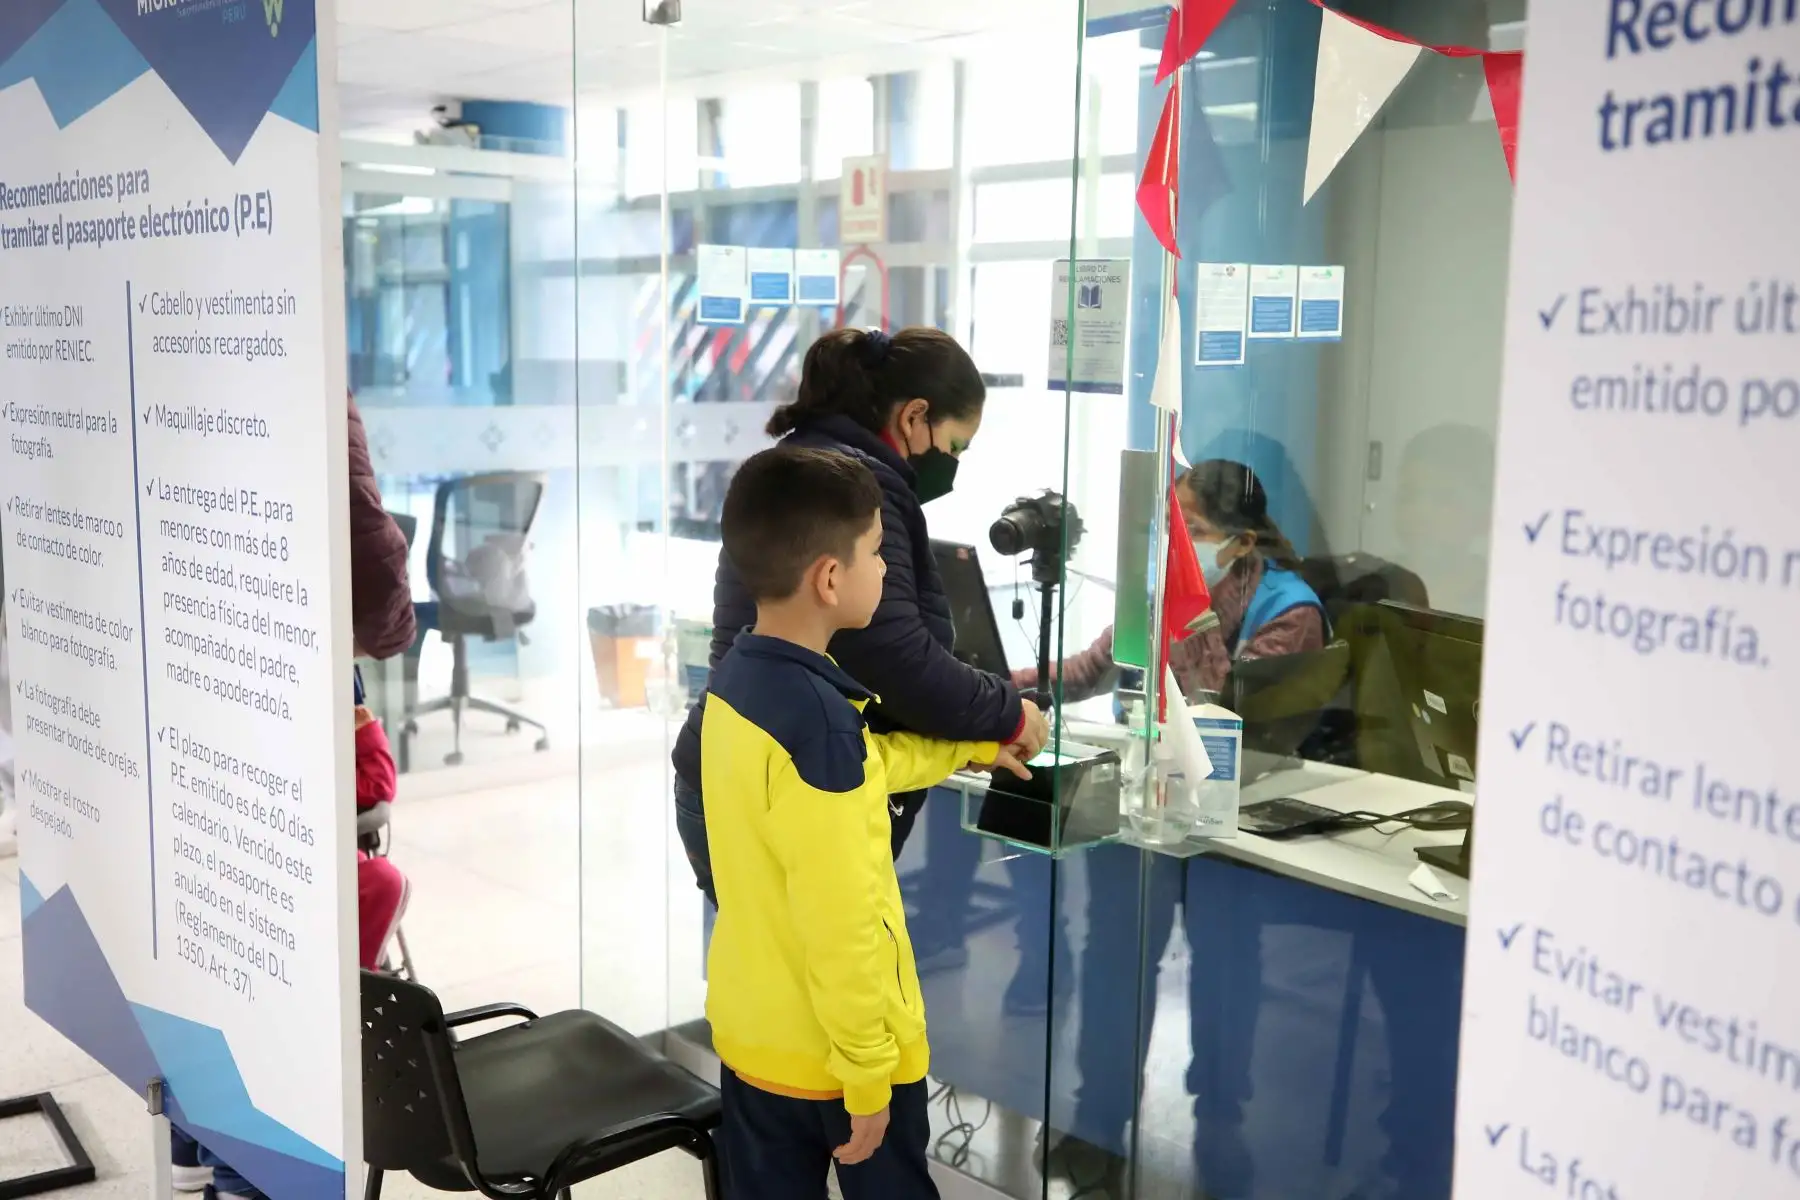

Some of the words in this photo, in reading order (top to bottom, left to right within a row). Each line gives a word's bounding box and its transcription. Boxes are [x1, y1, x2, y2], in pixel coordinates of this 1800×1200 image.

[0, 170, 113, 211] Recomendaciones
[117, 168, 149, 203] para
[1, 217, 49, 250] tramitar
[52, 214, 64, 245] el
[66, 211, 136, 250] pasaporte
[140, 200, 230, 238] electrónico
[234, 189, 273, 238] (P.E)
[4, 305, 33, 327] Exhibir
[35, 305, 63, 327] último
[65, 305, 83, 327] DNI
[151, 291, 194, 316] Cabello
[196, 297, 203, 320] y
[206, 291, 274, 316] vestimenta
[277, 289, 296, 315] sin
[1576, 283, 1725, 336] Exhibir
[7, 338, 37, 359] emitido
[39, 344, 53, 364] por
[56, 340, 95, 362] RENIEC.
[152, 330, 211, 356] accesorios
[214, 330, 288, 362] recargados.
[1570, 362, 1728, 416] emitido
[10, 401, 51, 428] Expresión
[51, 408, 84, 430] neutral
[85, 414, 107, 435] para
[109, 410, 117, 434] la
[155, 403, 214, 438] Maquillaje
[216, 408, 270, 438] discreto.
[11, 433, 54, 460] fotografía.
[15, 496, 43, 520] Retirar
[45, 501, 71, 527] lentes
[72, 507, 84, 530] de
[85, 515, 115, 537] marco
[117, 522, 123, 538] o
[158, 477, 171, 501] La
[173, 486, 217, 513] entrega
[219, 487, 237, 510] del
[240, 489, 262, 517] P.E.
[264, 497, 294, 524] para
[16, 529, 27, 548] de
[28, 533, 64, 557] contacto
[65, 539, 77, 560] de
[78, 544, 104, 568] color.
[160, 517, 208, 545] menores
[210, 529, 232, 550] con
[234, 528, 259, 555] más
[261, 533, 277, 558] de
[280, 535, 289, 561] 8
[1560, 508, 1768, 584] Expresión
[162, 552, 187, 577] años
[189, 553, 203, 581] de
[205, 561, 238, 591] edad,
[239, 569, 294, 604] requiere
[296, 577, 309, 607] la
[19, 588, 44, 613] Evitar
[45, 596, 94, 631] vestimenta
[95, 609, 107, 634] de
[108, 615, 133, 643] color
[163, 589, 216, 621] presencia
[218, 597, 249, 631] física
[251, 607, 271, 638] del
[273, 620, 319, 654] menor,
[1555, 580, 1770, 668] fotografía.
[21, 619, 48, 646] blanco
[50, 632, 69, 654] para
[70, 635, 117, 671] fotografía.
[164, 624, 236, 664] acompañado
[238, 643, 257, 671] del
[259, 653, 300, 687] padre,
[25, 679, 35, 700] La
[35, 684, 77, 718] fotografía
[78, 700, 101, 729] debe
[166, 659, 201, 689] madre
[203, 672, 211, 686] o
[212, 675, 293, 722] apoderado/a.
[26, 714, 65, 744] presentar
[66, 728, 93, 759] borde
[94, 742, 107, 764] de
[108, 752, 140, 779] orejas.
[169, 726, 180, 750] El
[181, 733, 211, 765] plazo
[213, 747, 239, 772] para
[241, 761, 289, 800] recoger
[291, 776, 303, 803] el
[1546, 722, 1684, 801] Retirar
[29, 769, 62, 801] Mostrar
[64, 785, 72, 806] el
[73, 795, 101, 823] rostro
[30, 803, 74, 840] despejado.
[171, 761, 189, 790] P.E.
[191, 770, 234, 809] emitido
[235, 795, 249, 818] es
[251, 797, 267, 825] de
[269, 805, 286, 834] 60
[288, 814, 315, 847] días
[171, 800, 232, 846] calendario.
[234, 824, 283, 870] Vencido
[285, 855, 313, 885] este
[1539, 794, 1586, 846] de
[1592, 818, 1784, 916] contacto
[206, 846, 216, 872] el
[219, 858, 277, 905] pasaporte
[280, 893, 295, 914] es
[174, 870, 217, 909] anulado
[219, 893, 234, 917] en
[236, 898, 247, 924] el
[249, 906, 296, 951] sistema
[175, 898, 246, 959] (Reglamento
[247, 941, 265, 971] del
[209, 955, 231, 986] Art.
[232, 968, 255, 1004] 37).
[1532, 928, 1643, 1013] Evitar
[1528, 994, 1650, 1094] blanco
[1659, 1072, 1758, 1151] para
[1519, 1127, 1557, 1186] La
